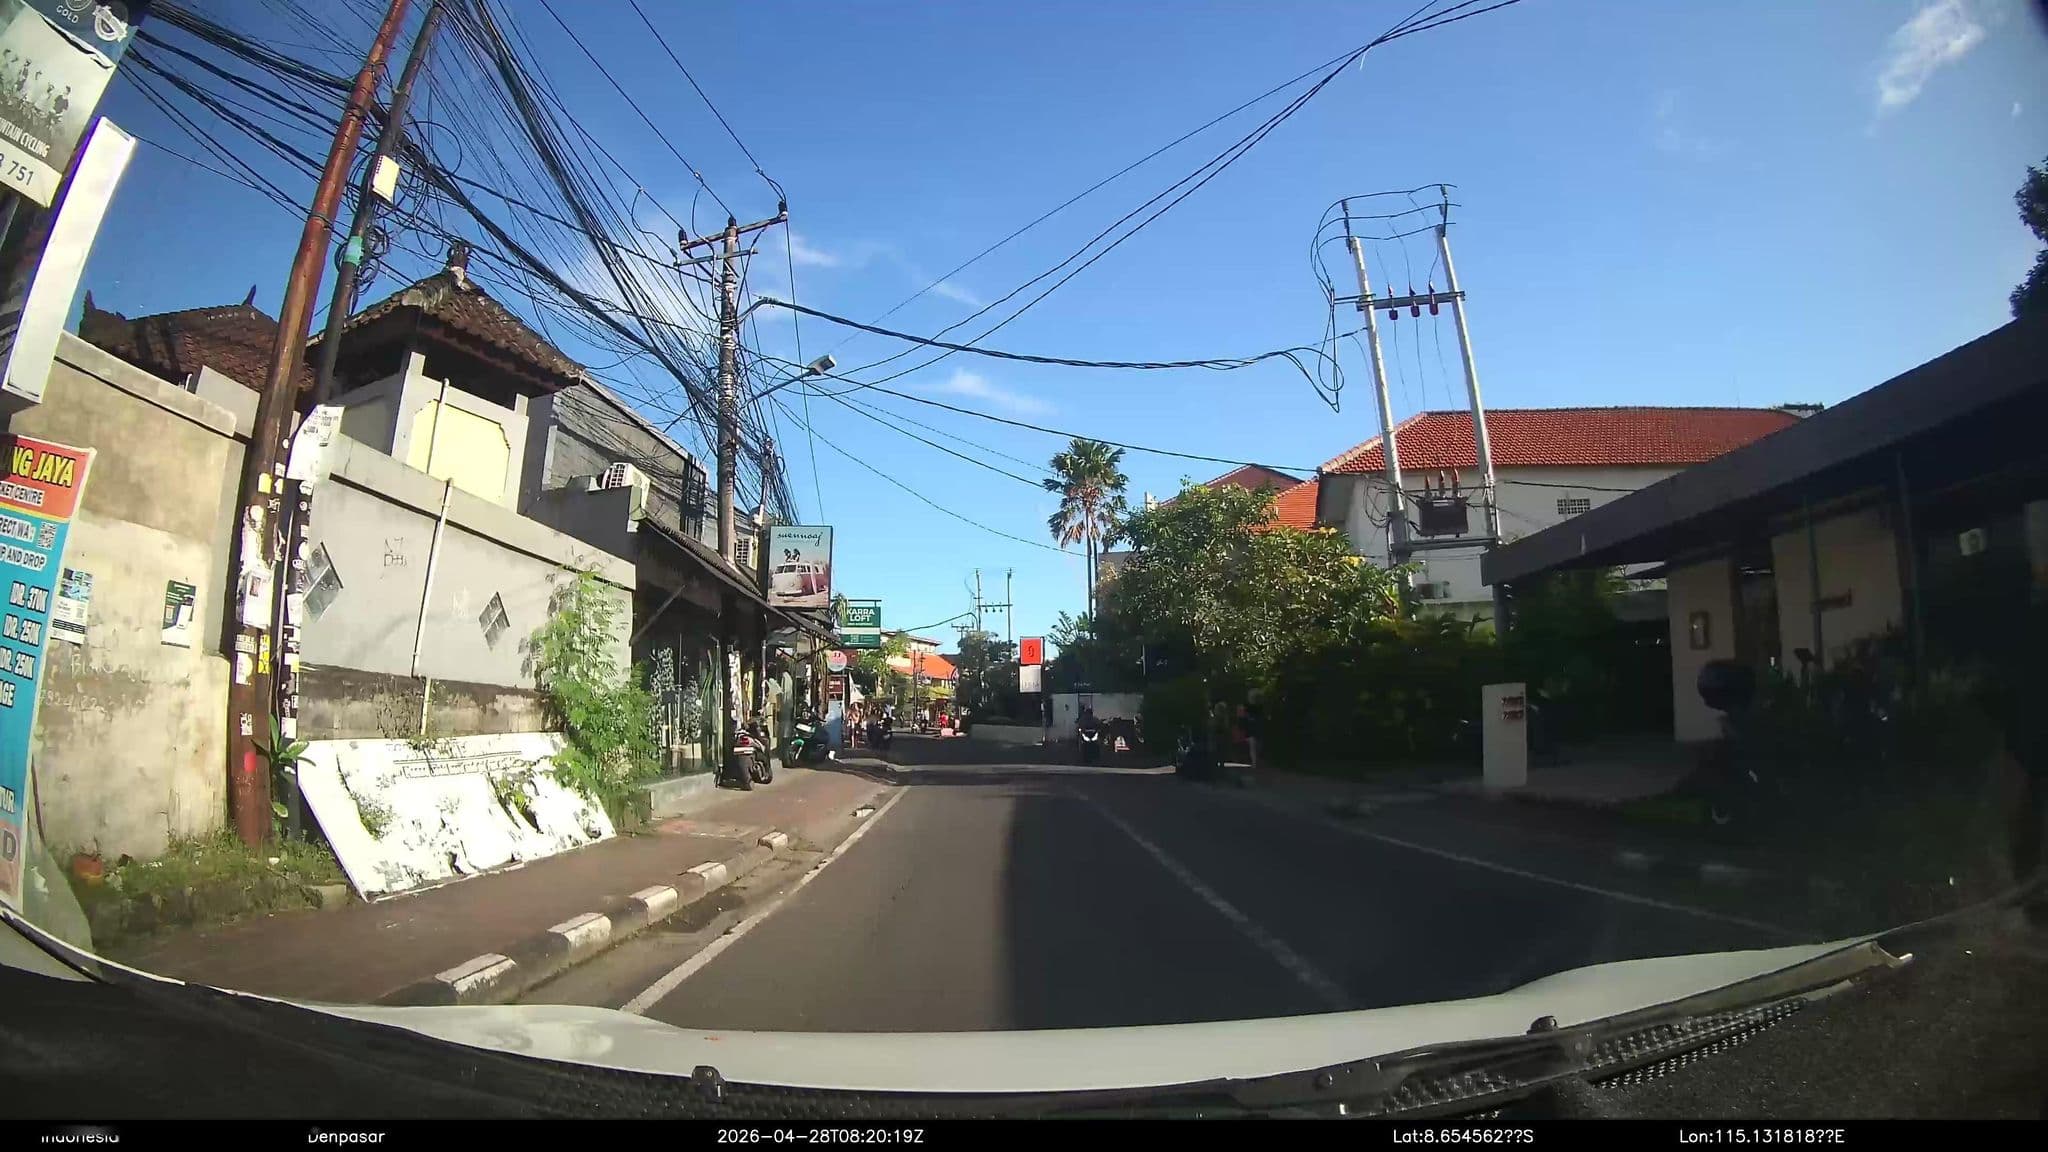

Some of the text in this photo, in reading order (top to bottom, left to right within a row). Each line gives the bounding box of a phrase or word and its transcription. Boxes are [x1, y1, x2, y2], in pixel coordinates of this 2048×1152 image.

[56, 5, 79, 24] GOLD
[20, 132, 50, 158] CYCLING
[7, 160, 34, 186] 751
[32, 452, 76, 488] JAYA
[15, 487, 43, 504] CENTRE
[7, 548, 22, 563] AND
[23, 552, 45, 568] DROP
